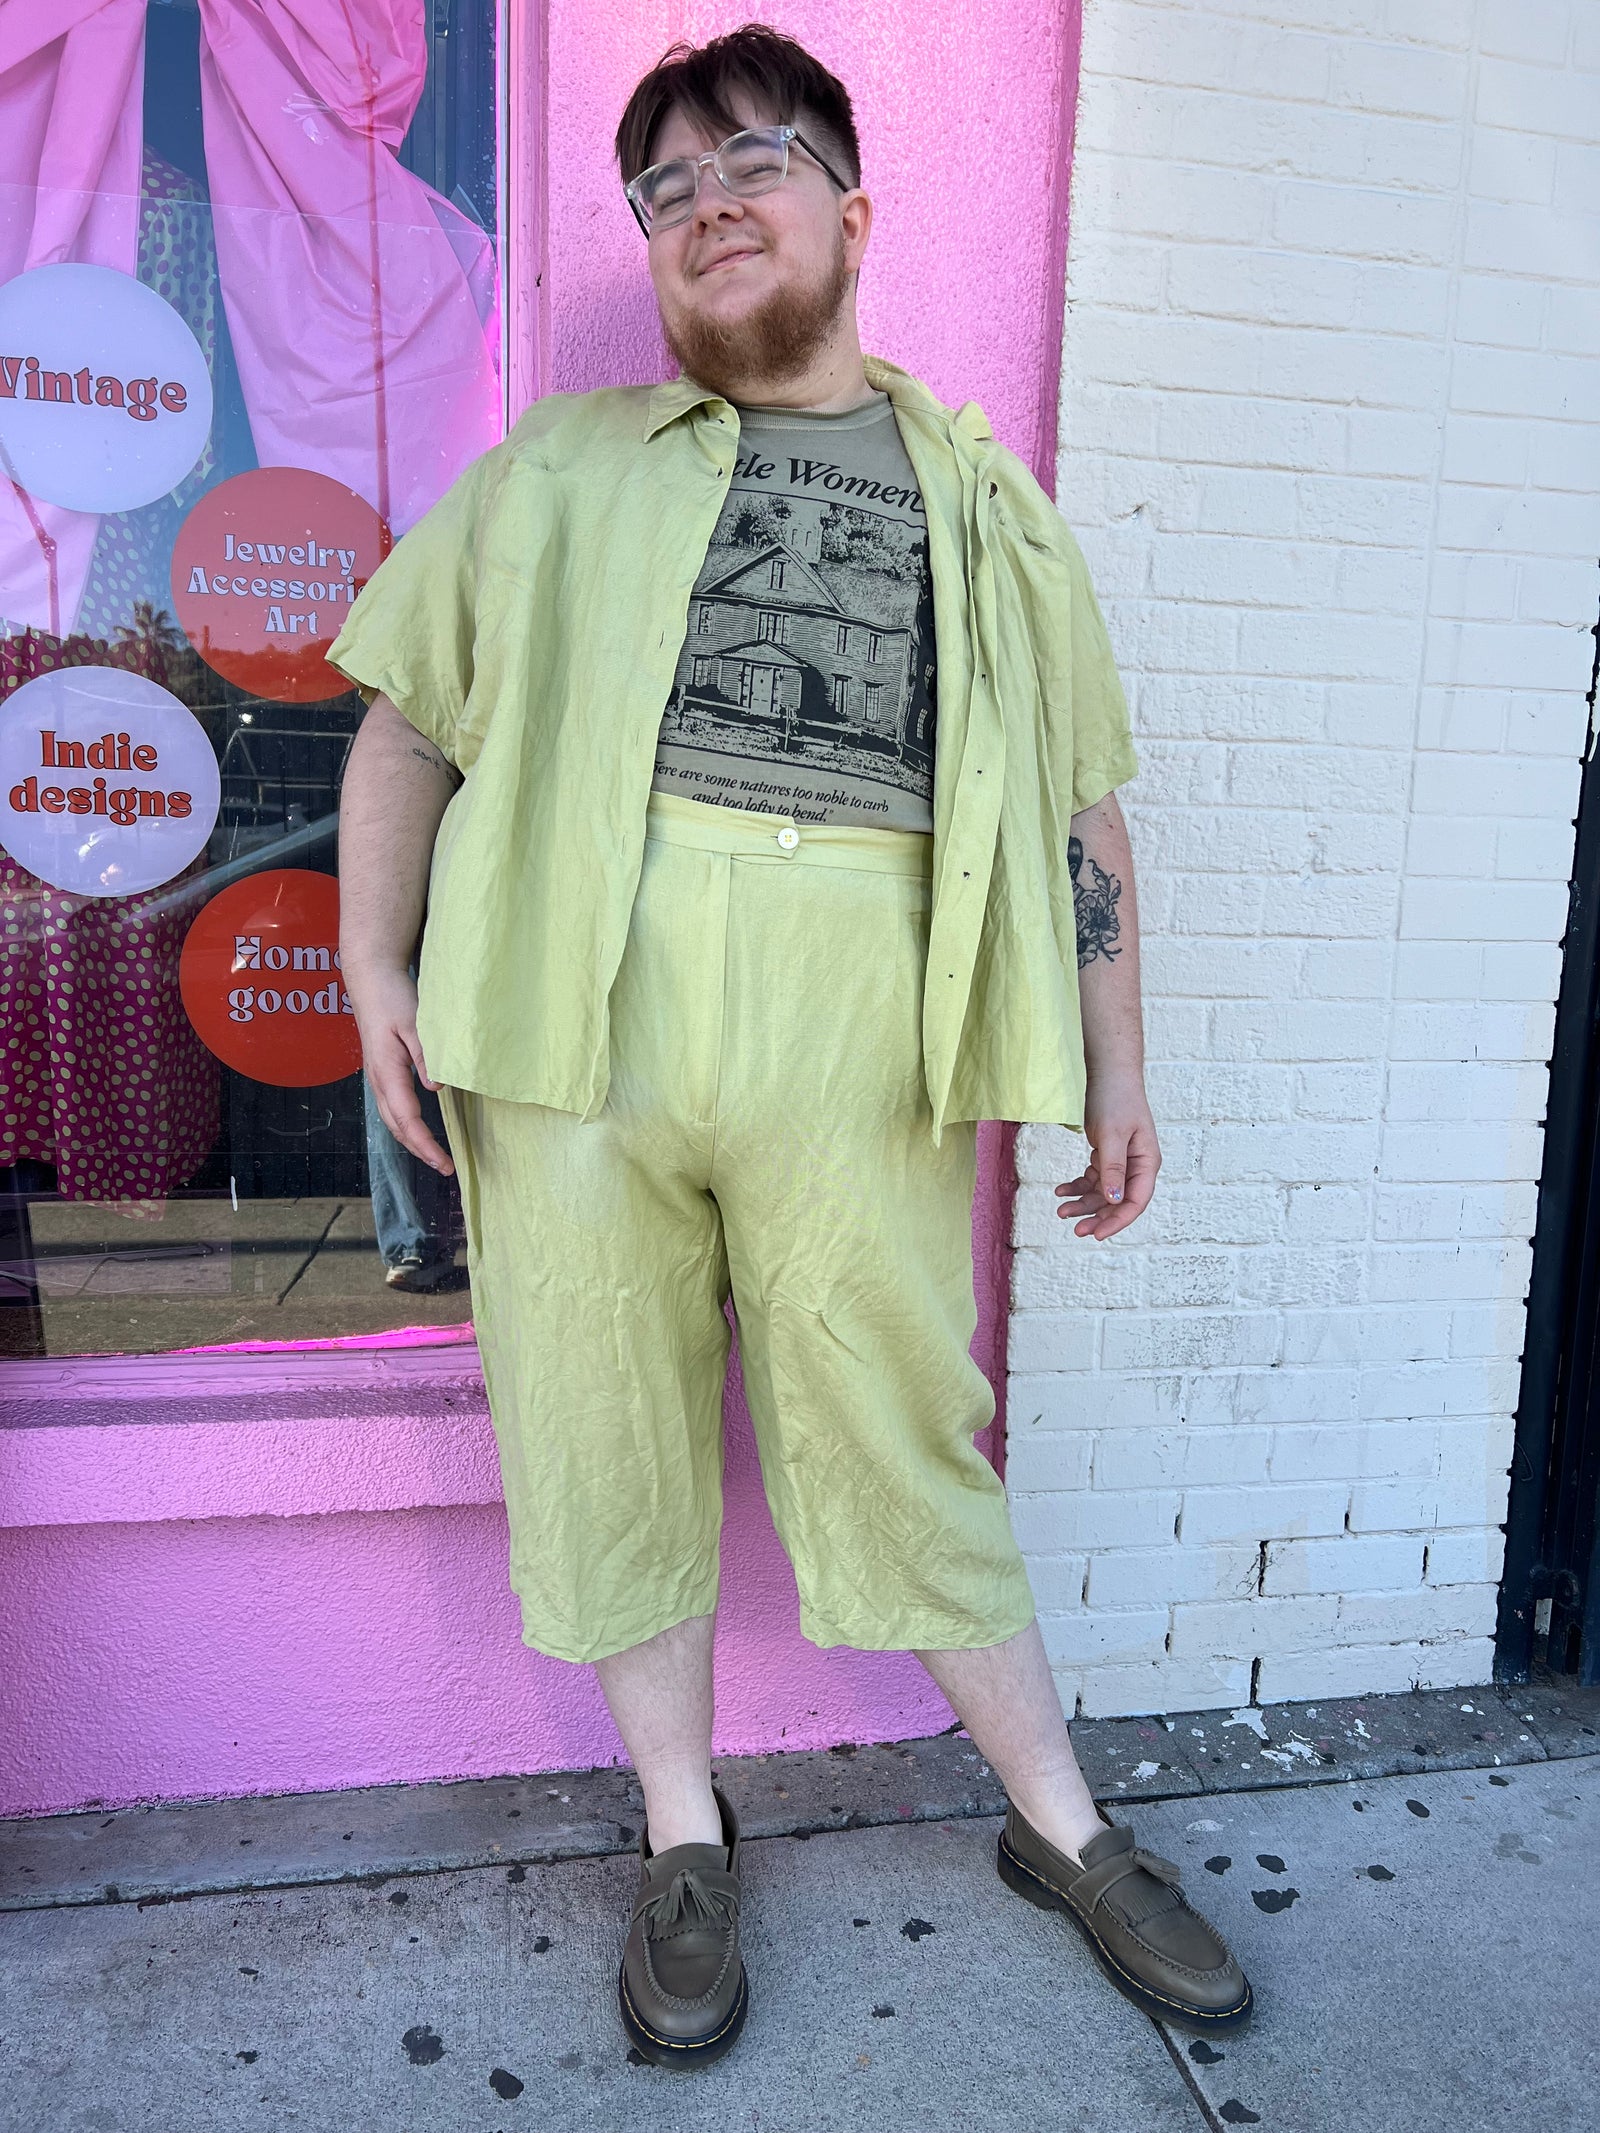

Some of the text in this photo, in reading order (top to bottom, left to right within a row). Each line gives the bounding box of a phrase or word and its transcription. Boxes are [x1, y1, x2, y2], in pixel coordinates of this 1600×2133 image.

[0, 356, 187, 421] Vintage
[786, 457, 926, 513] Women
[224, 534, 356, 576] Jewelry
[187, 566, 367, 603] Accessori
[264, 605, 319, 635] Art
[40, 730, 158, 772] Indie
[9, 776, 192, 826] designs
[654, 760, 889, 813] ere are some natures too noble to curb
[692, 792, 722, 806] and
[723, 796, 743, 809] too
[777, 804, 790, 816] to
